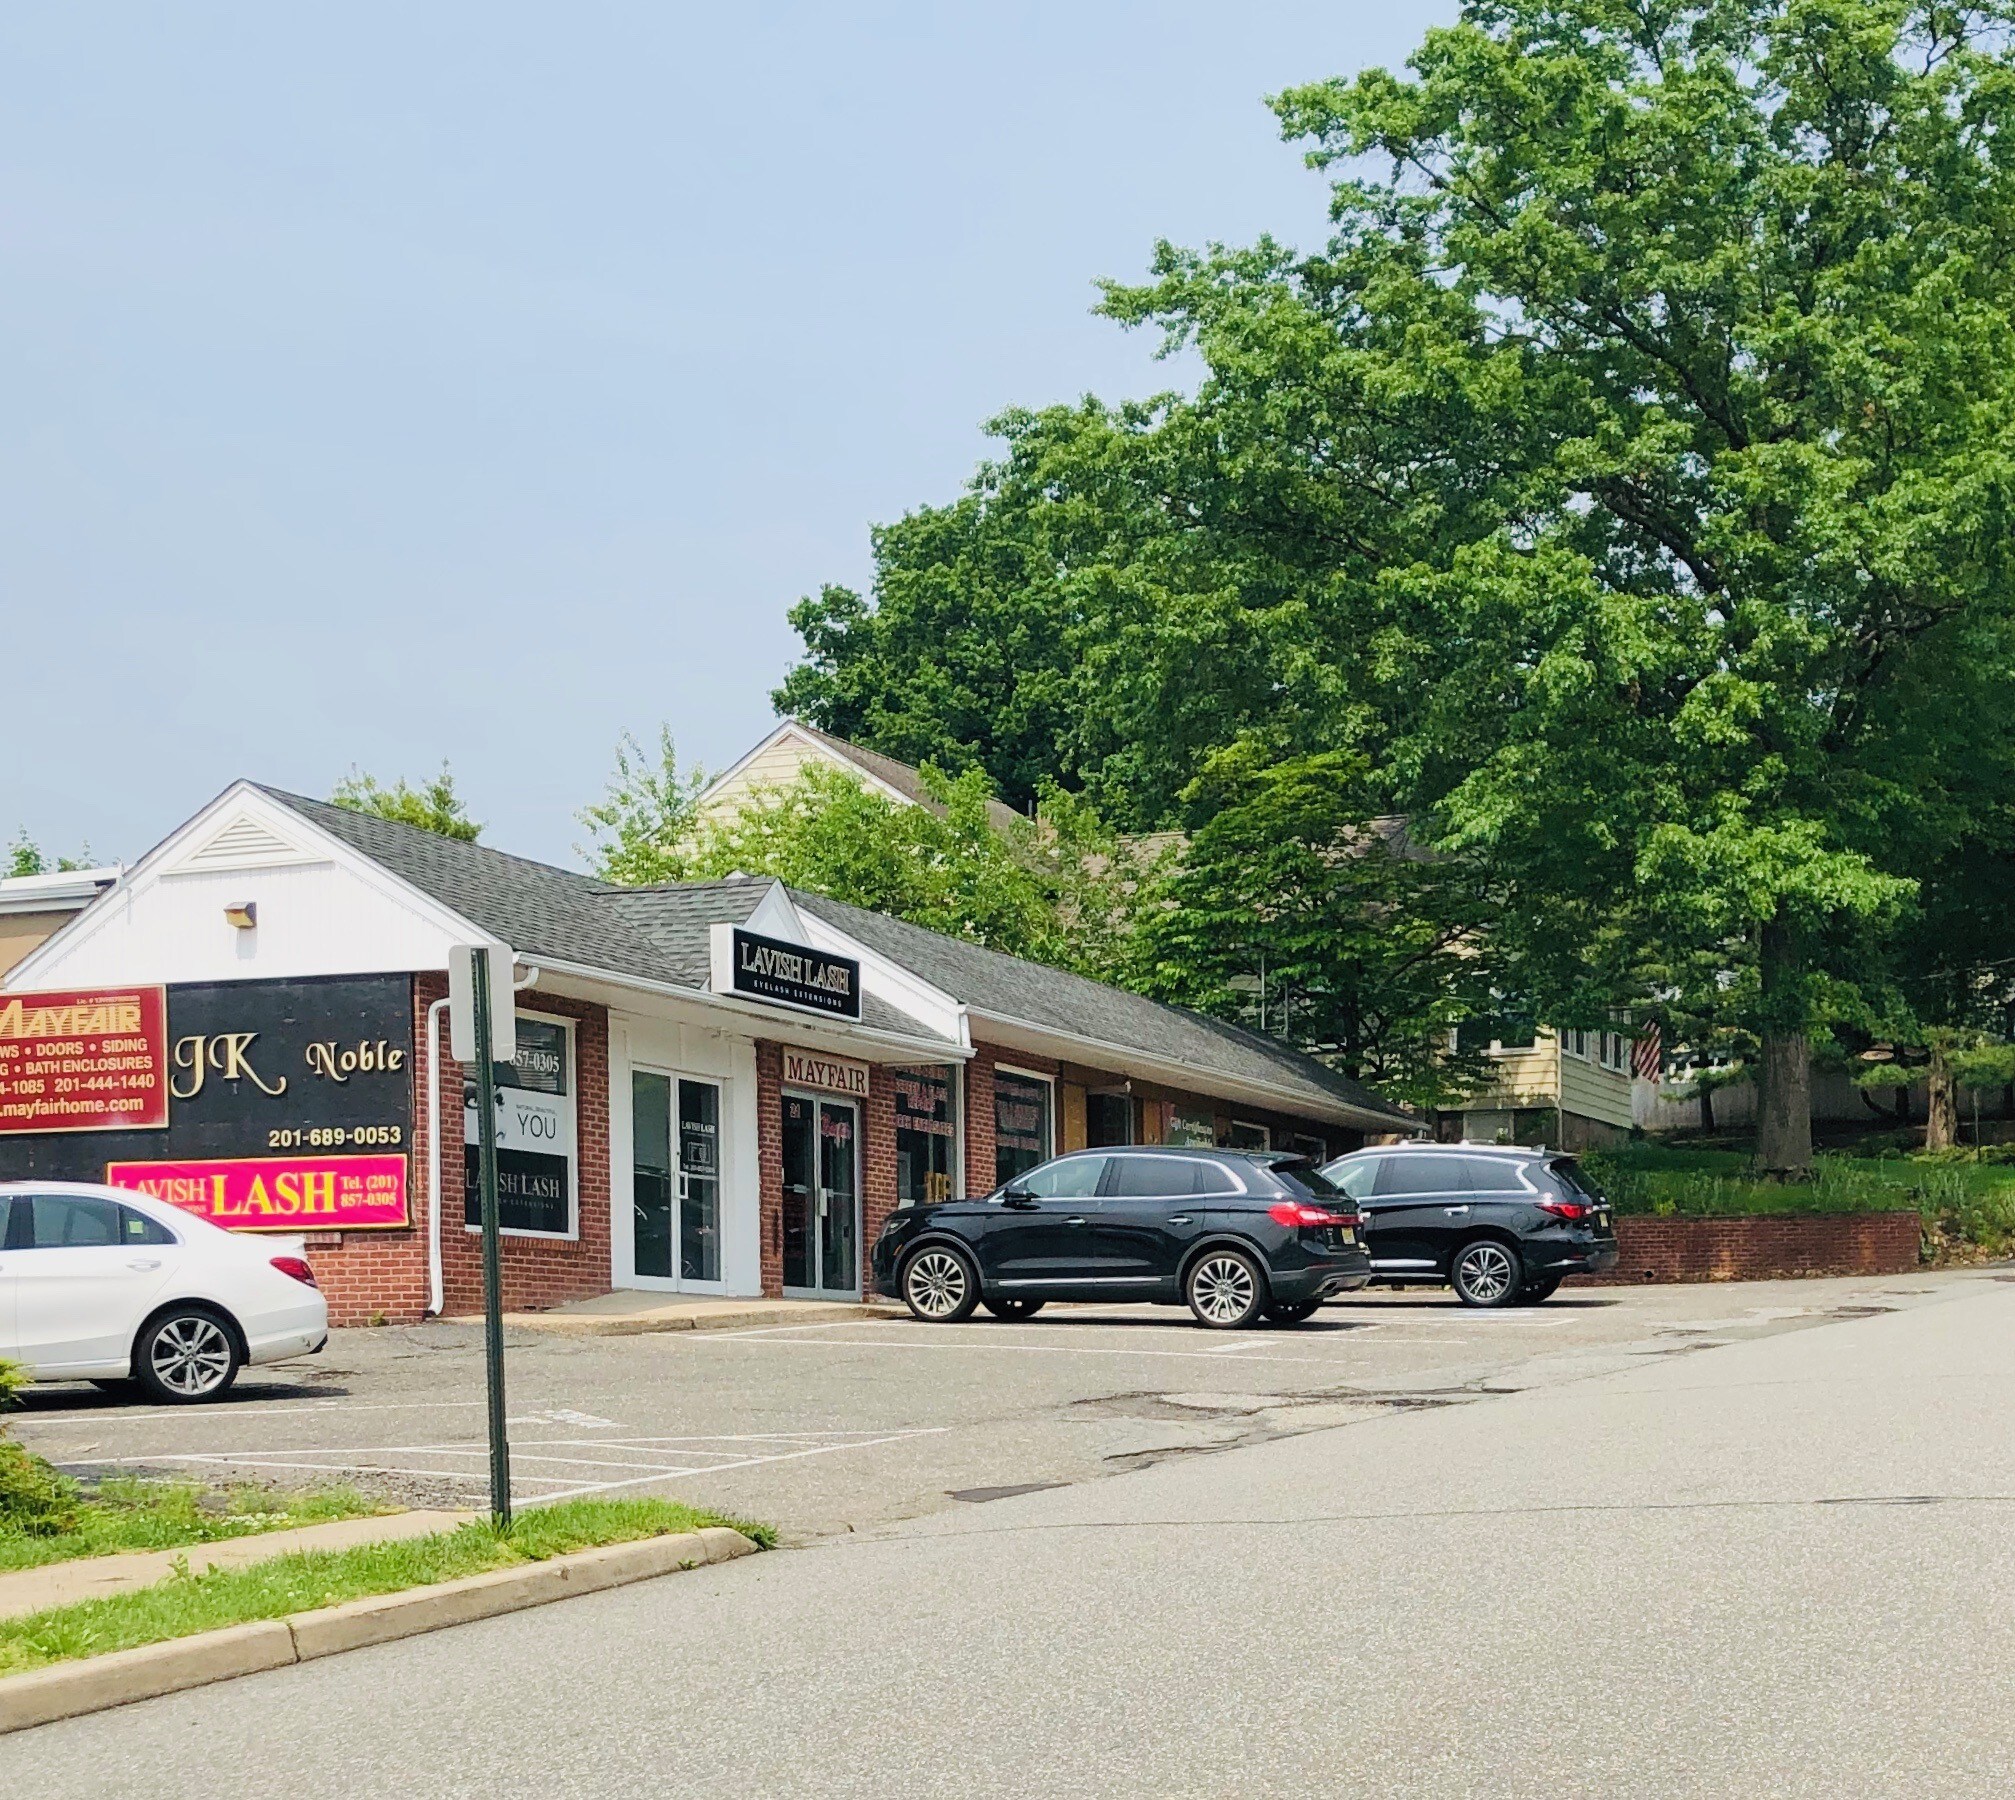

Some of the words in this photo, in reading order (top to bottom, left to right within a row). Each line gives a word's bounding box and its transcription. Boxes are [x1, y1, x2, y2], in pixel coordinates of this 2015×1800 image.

[741, 941, 803, 984] LAVISH
[804, 958, 850, 996] LASH
[36, 1041, 84, 1057] DOORS
[102, 1037, 148, 1054] SIDING
[25, 1060, 61, 1075] BATH
[62, 1056, 153, 1073] ENCLOSURES
[170, 1032, 287, 1099] JK
[305, 1039, 405, 1082] Noble
[787, 1055, 866, 1094] MAYFAIR
[54, 1073, 155, 1093] 201-444-1440
[268, 1125, 402, 1148] 201-689-0053
[517, 1112, 556, 1139] YOU
[210, 1170, 338, 1216] LASH
[340, 1175, 364, 1191] Tel.
[366, 1174, 399, 1191] (201)
[521, 1173, 560, 1198] LASH
[340, 1191, 397, 1208] 857-0305
